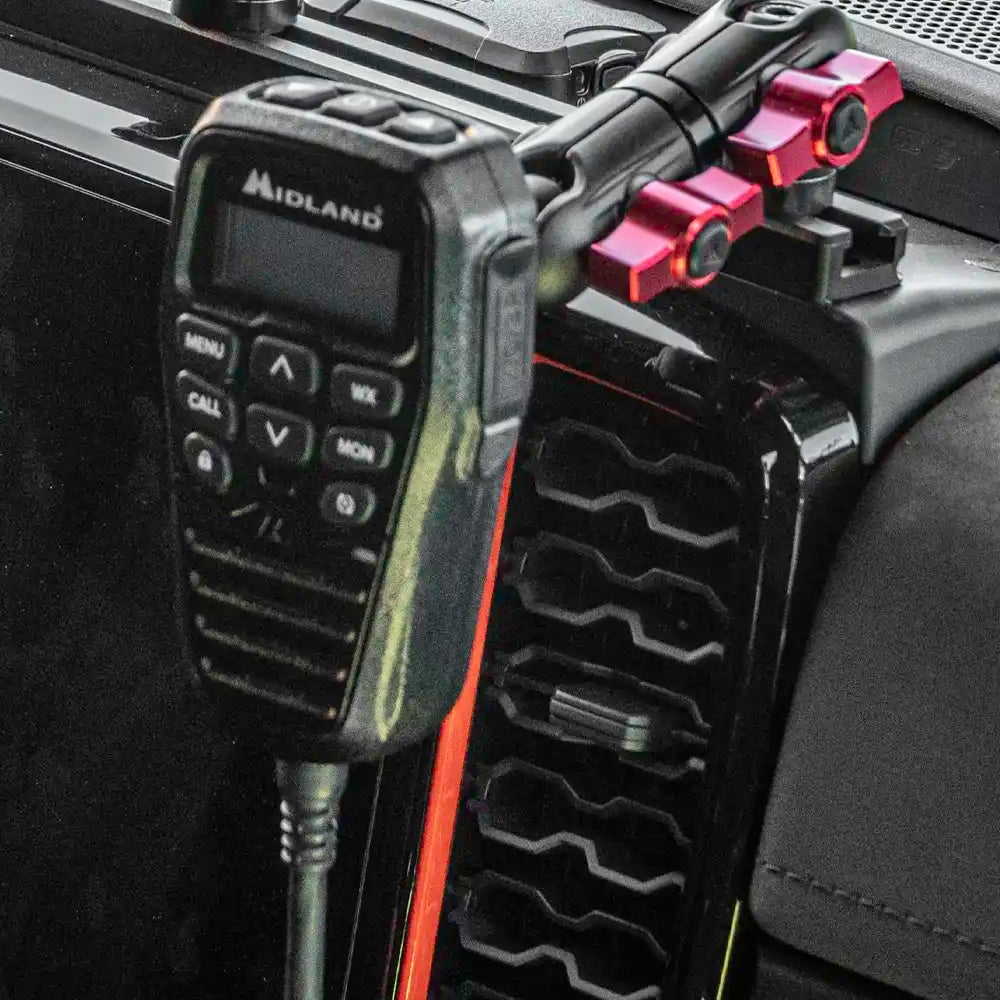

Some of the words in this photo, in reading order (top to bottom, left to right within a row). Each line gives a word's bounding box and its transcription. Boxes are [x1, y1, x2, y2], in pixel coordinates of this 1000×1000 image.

[184, 331, 225, 361] MENU
[187, 391, 222, 419] CALL
[336, 436, 375, 464] MON
